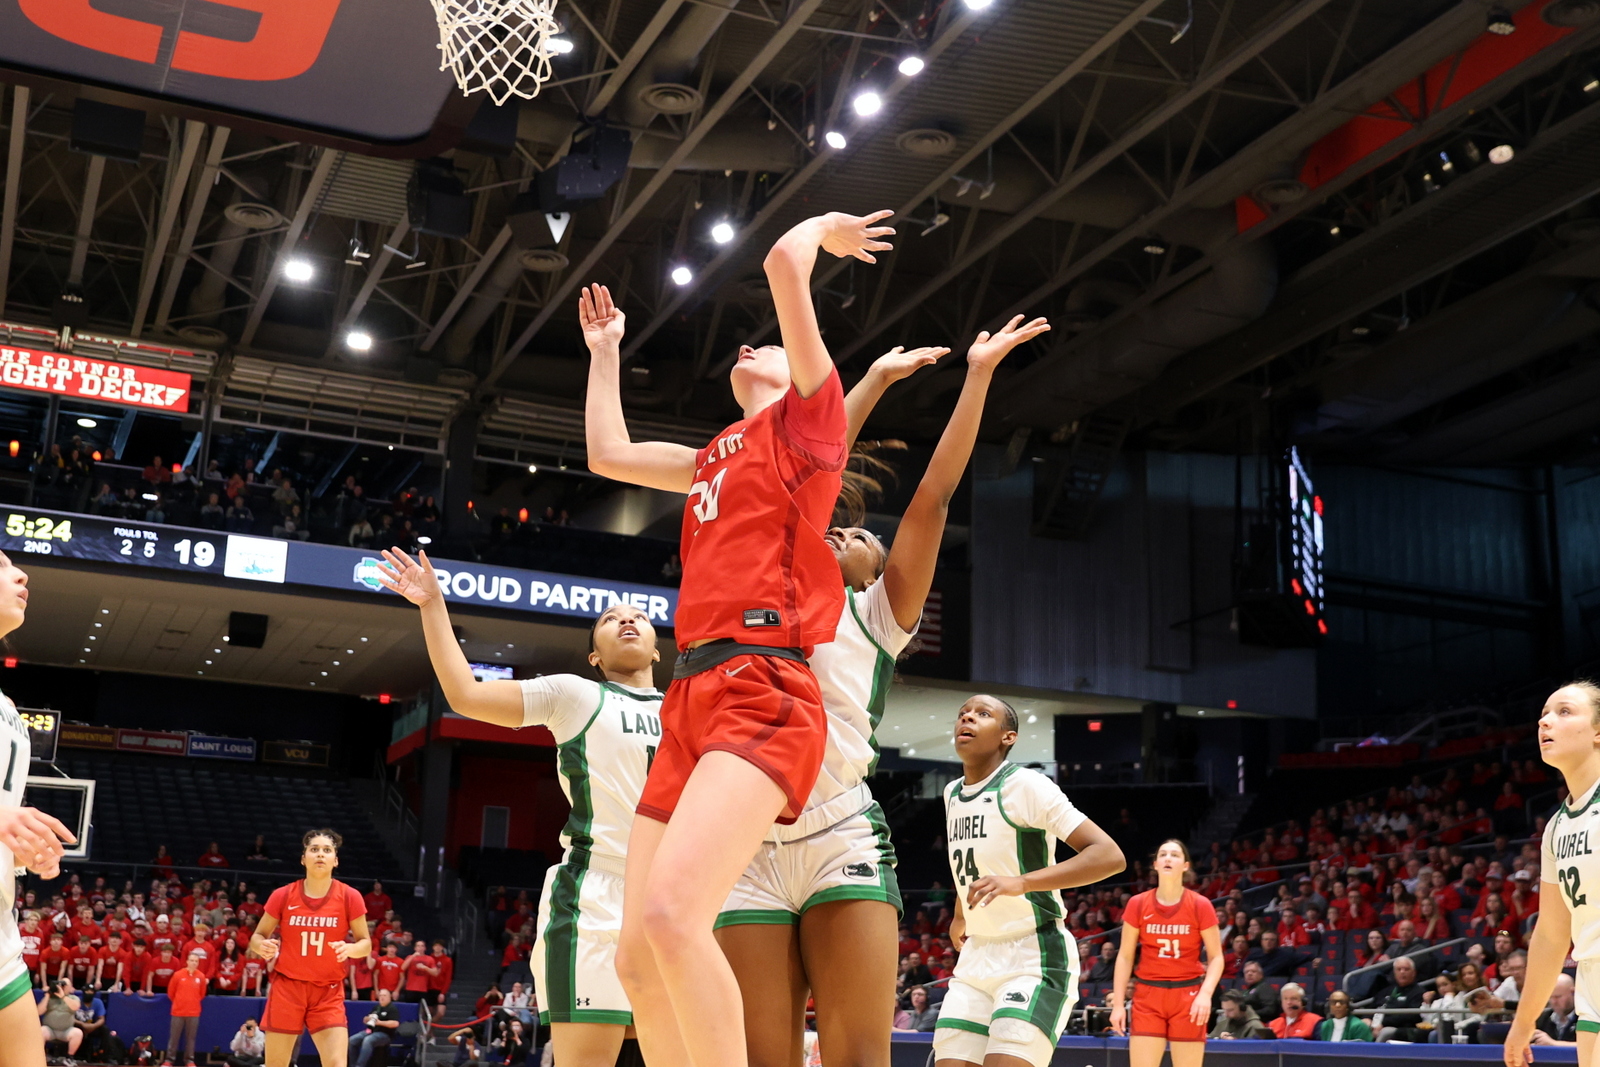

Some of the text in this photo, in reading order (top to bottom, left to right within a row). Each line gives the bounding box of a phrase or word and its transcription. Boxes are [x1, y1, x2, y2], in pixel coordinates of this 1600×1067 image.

[42, 355, 136, 381] CONNOR
[78, 373, 166, 406] DECK
[6, 514, 72, 542] 5:24
[113, 527, 159, 541] FOULS TOL
[23, 540, 52, 555] 2ND
[120, 539, 156, 558] 2 5
[173, 538, 216, 568] 19
[430, 568, 521, 603] ROUD
[530, 580, 669, 622] PARTNER
[769, 613, 775, 621] L
[20, 713, 54, 731] 5:23
[620, 710, 661, 737] LAU
[191, 741, 253, 755] SAINT LOUIS
[284, 748, 310, 759] VCU
[3, 738, 18, 793] 1
[949, 815, 987, 843] LAUREL
[953, 847, 981, 886] 24
[289, 915, 339, 928] BELLEVUE
[1146, 923, 1191, 935] BELLEVUE
[300, 931, 325, 957] 14
[1156, 938, 1180, 959] 21
